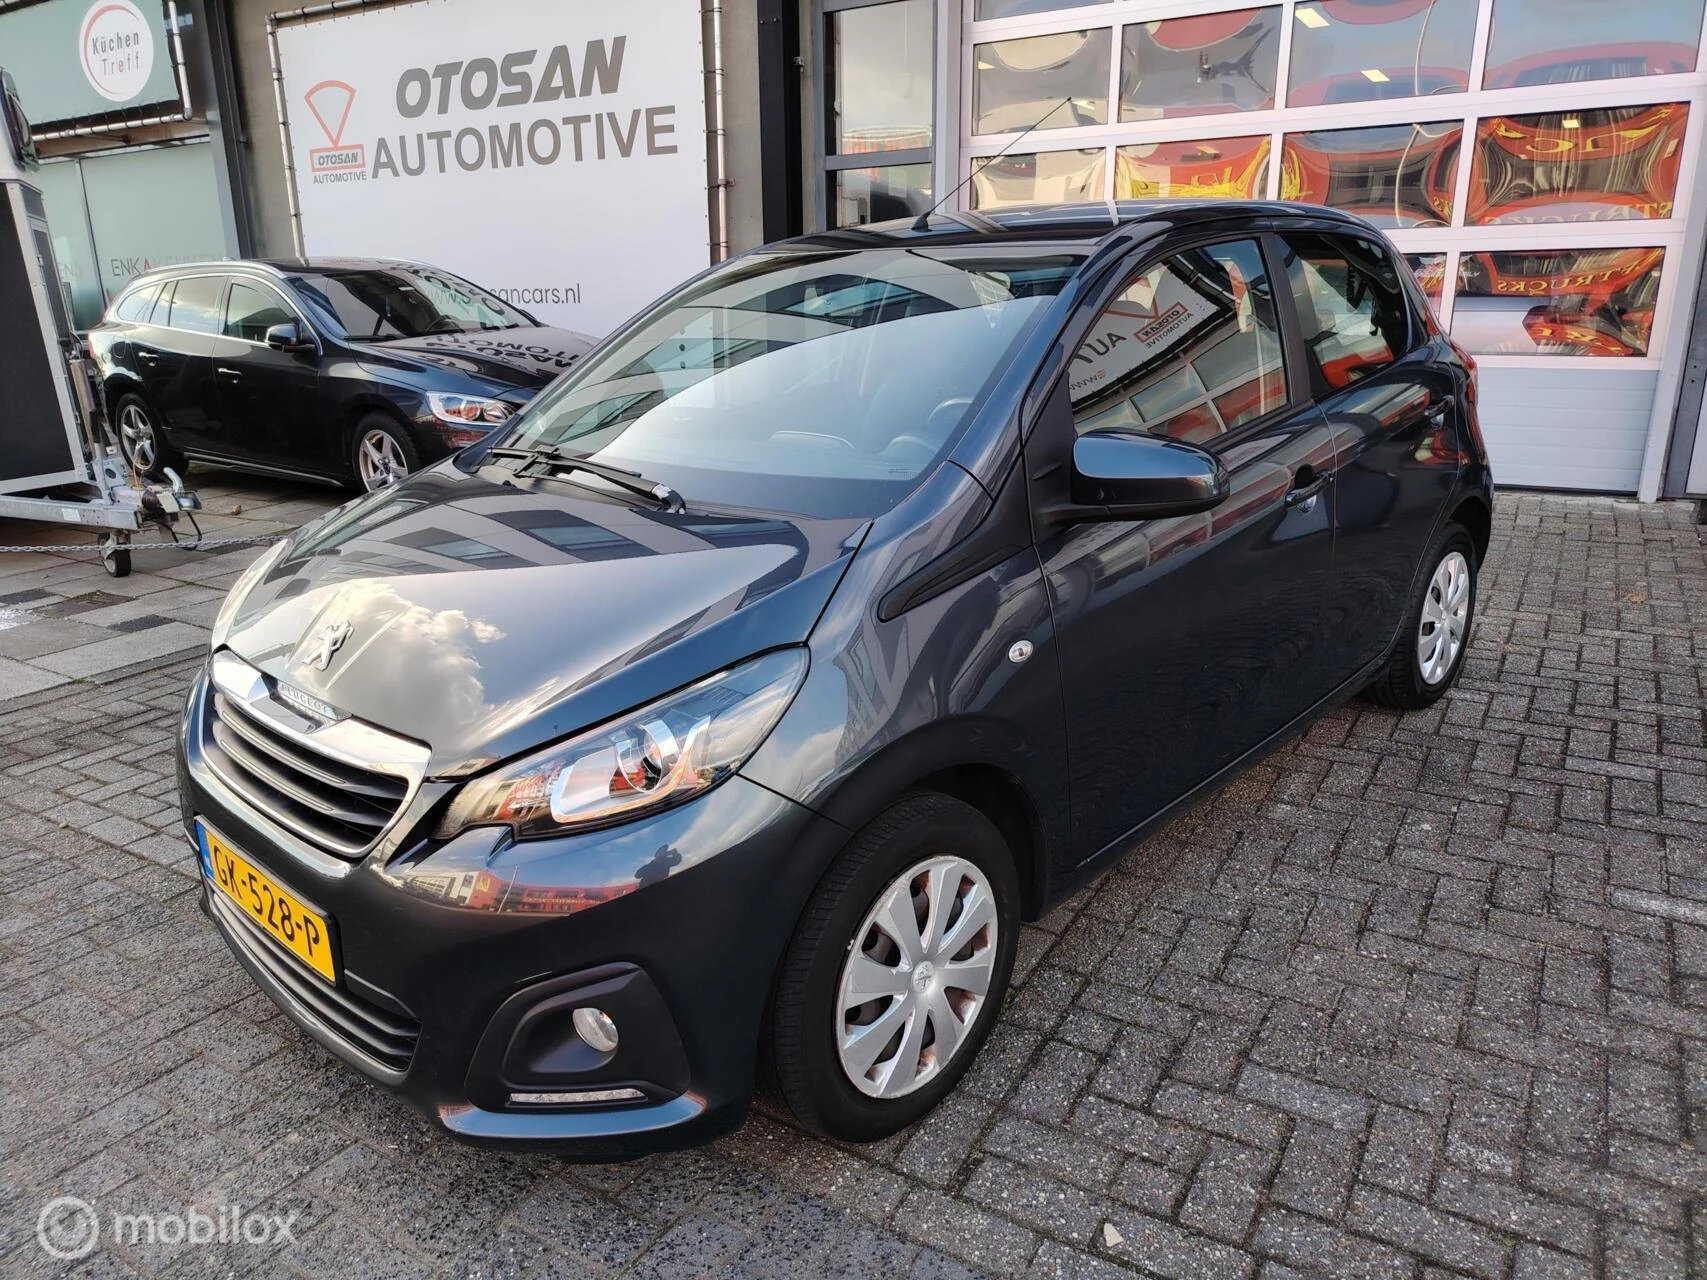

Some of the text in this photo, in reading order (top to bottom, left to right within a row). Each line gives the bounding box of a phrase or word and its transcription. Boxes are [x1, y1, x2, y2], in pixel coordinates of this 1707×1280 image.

[91, 31, 140, 54] Küchen
[100, 55, 140, 77] Treff
[395, 35, 627, 119] OTOSAN
[371, 105, 678, 179] AUTOMOTIVE
[317, 151, 359, 167] OTOSAN
[313, 170, 367, 184] AUTOMOTIVE
[212, 844, 321, 957] GK-528-P
